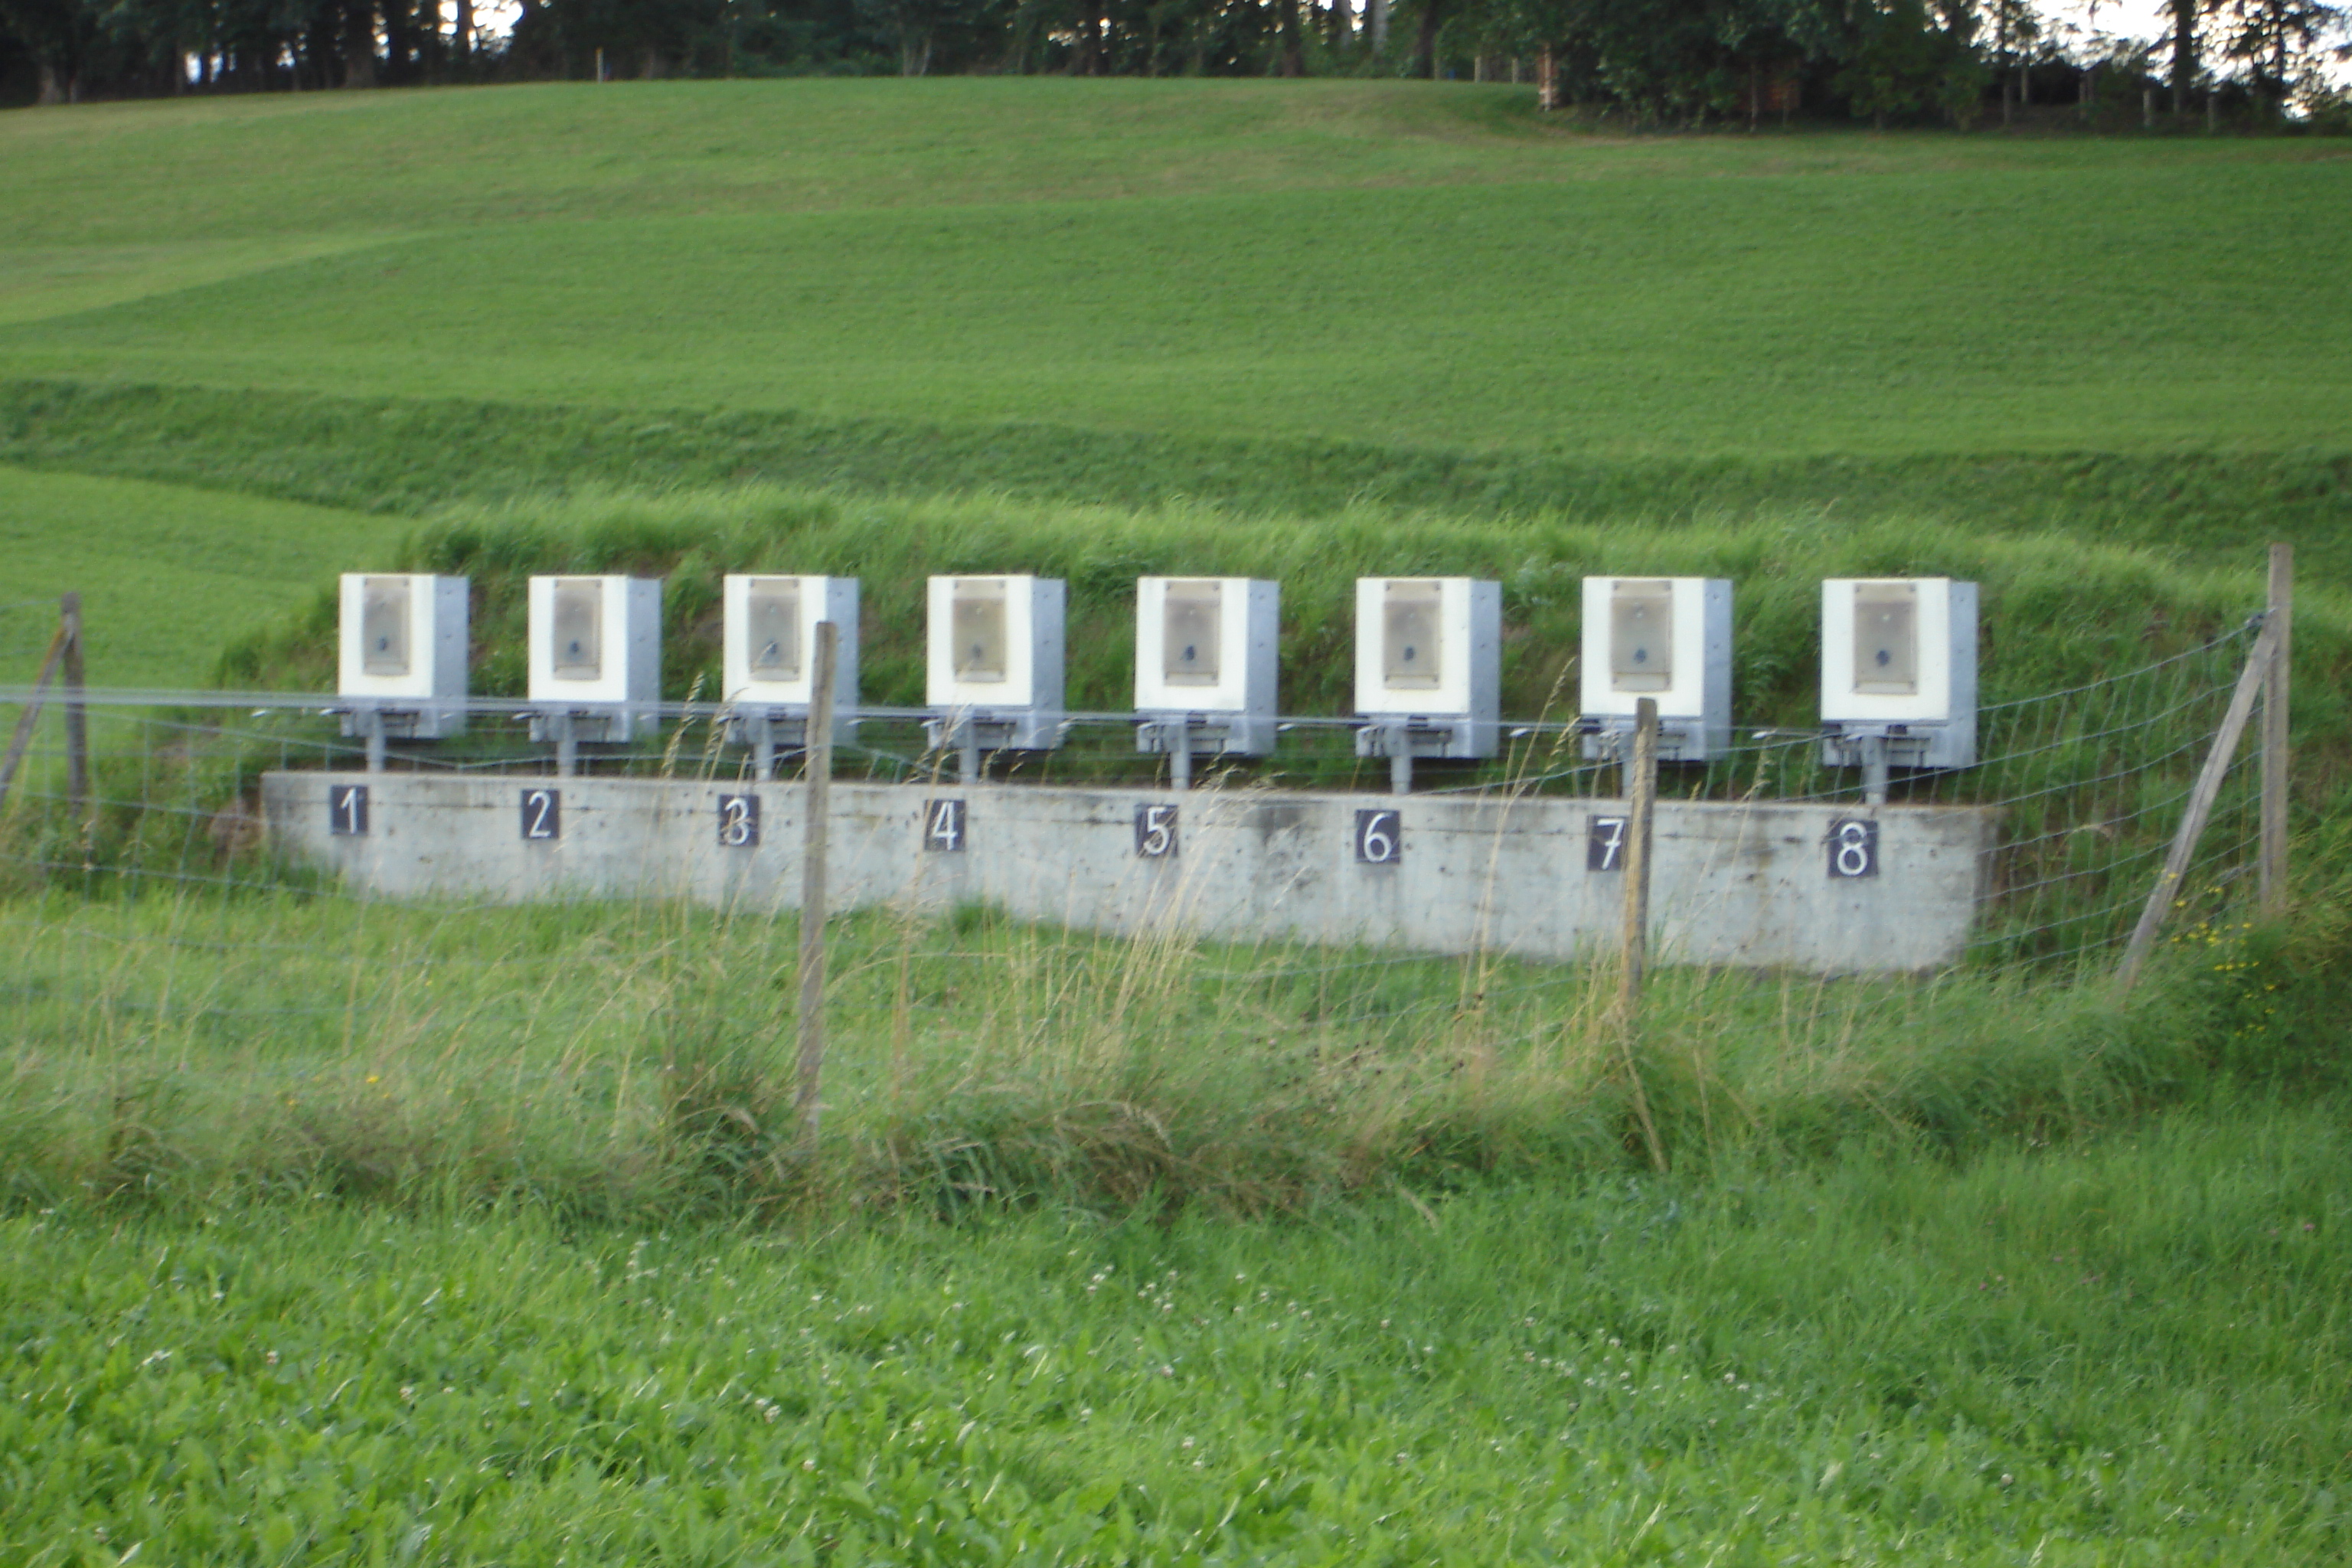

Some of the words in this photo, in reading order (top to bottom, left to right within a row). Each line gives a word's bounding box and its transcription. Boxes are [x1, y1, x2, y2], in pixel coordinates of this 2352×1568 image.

[341, 789, 358, 834] 1
[528, 792, 551, 838] 2
[724, 798, 750, 844] 3
[932, 802, 957, 850] 4
[1143, 805, 1170, 854] 5
[1364, 812, 1392, 861] 6
[1597, 818, 1625, 870] 7
[1838, 822, 1867, 875] 8
